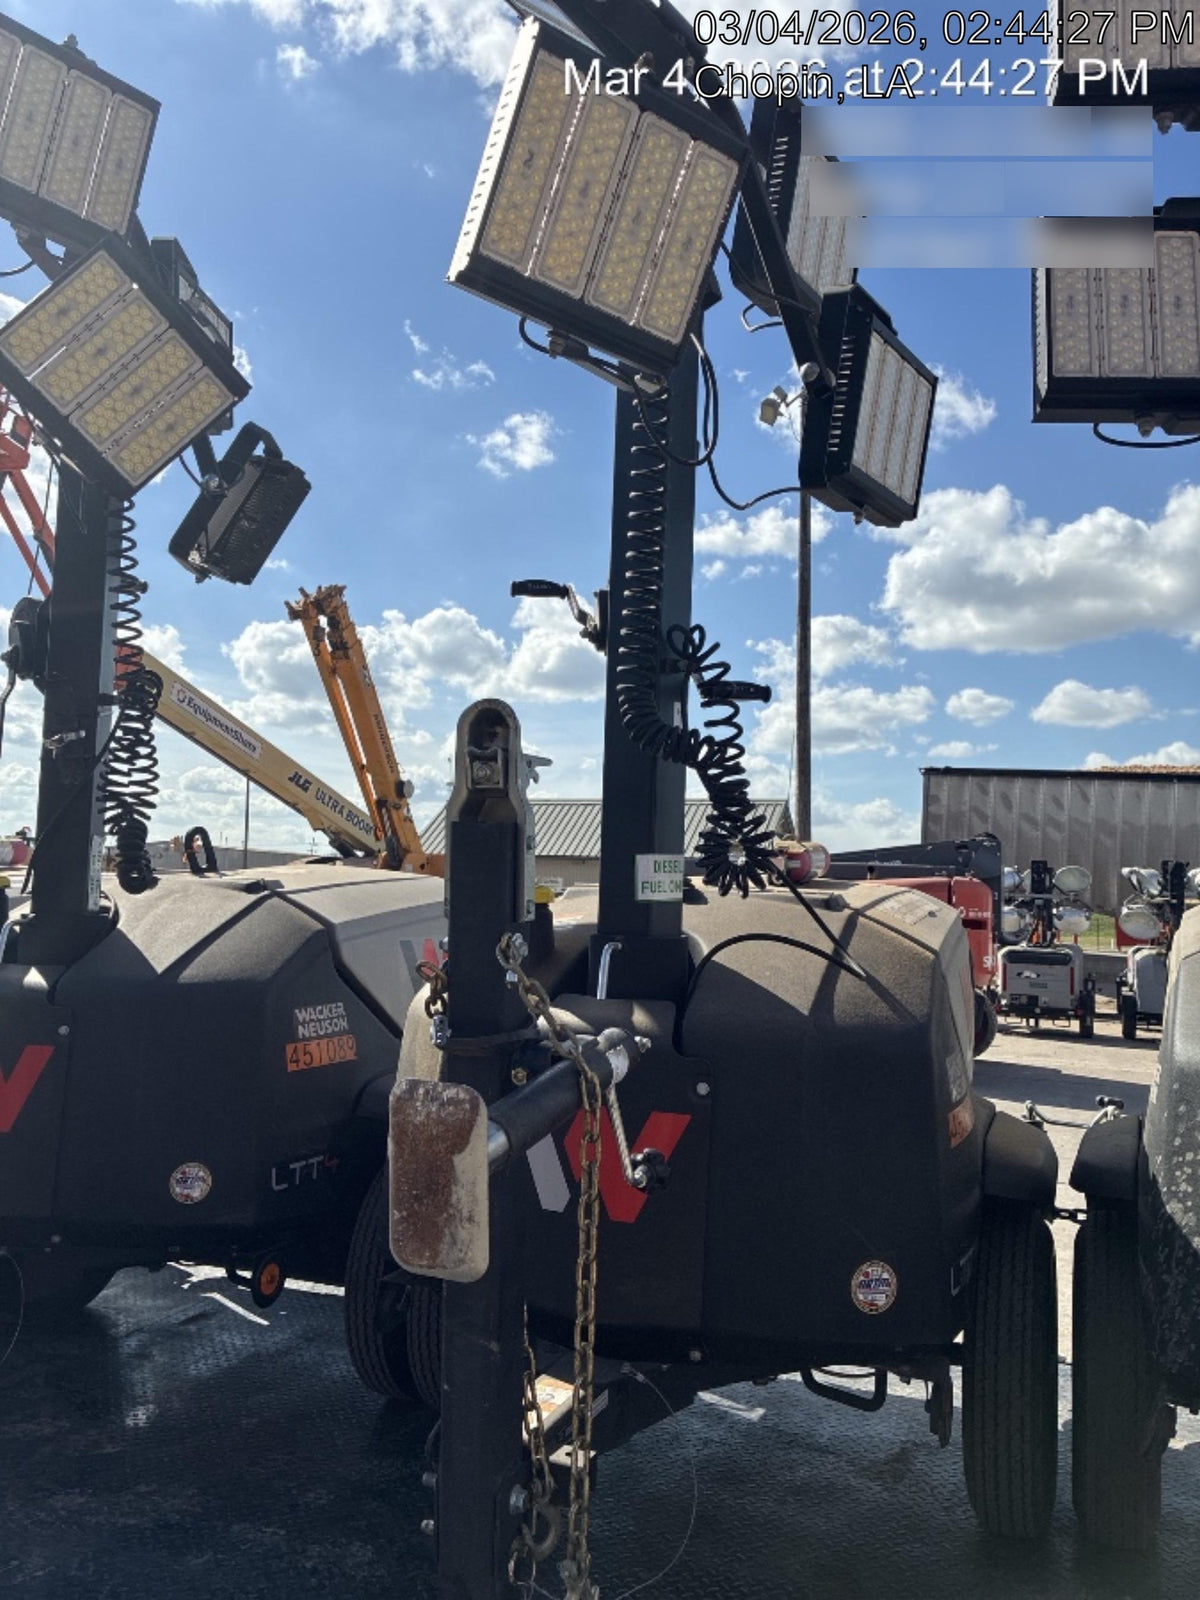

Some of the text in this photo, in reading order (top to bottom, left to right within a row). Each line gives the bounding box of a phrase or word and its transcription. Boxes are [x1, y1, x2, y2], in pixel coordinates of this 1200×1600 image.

[288, 771, 313, 793] JLG
[315, 787, 345, 818] ULTRA
[641, 881, 668, 894] FUEL
[295, 1002, 346, 1022] WACKER
[298, 1016, 349, 1038] NEUSON
